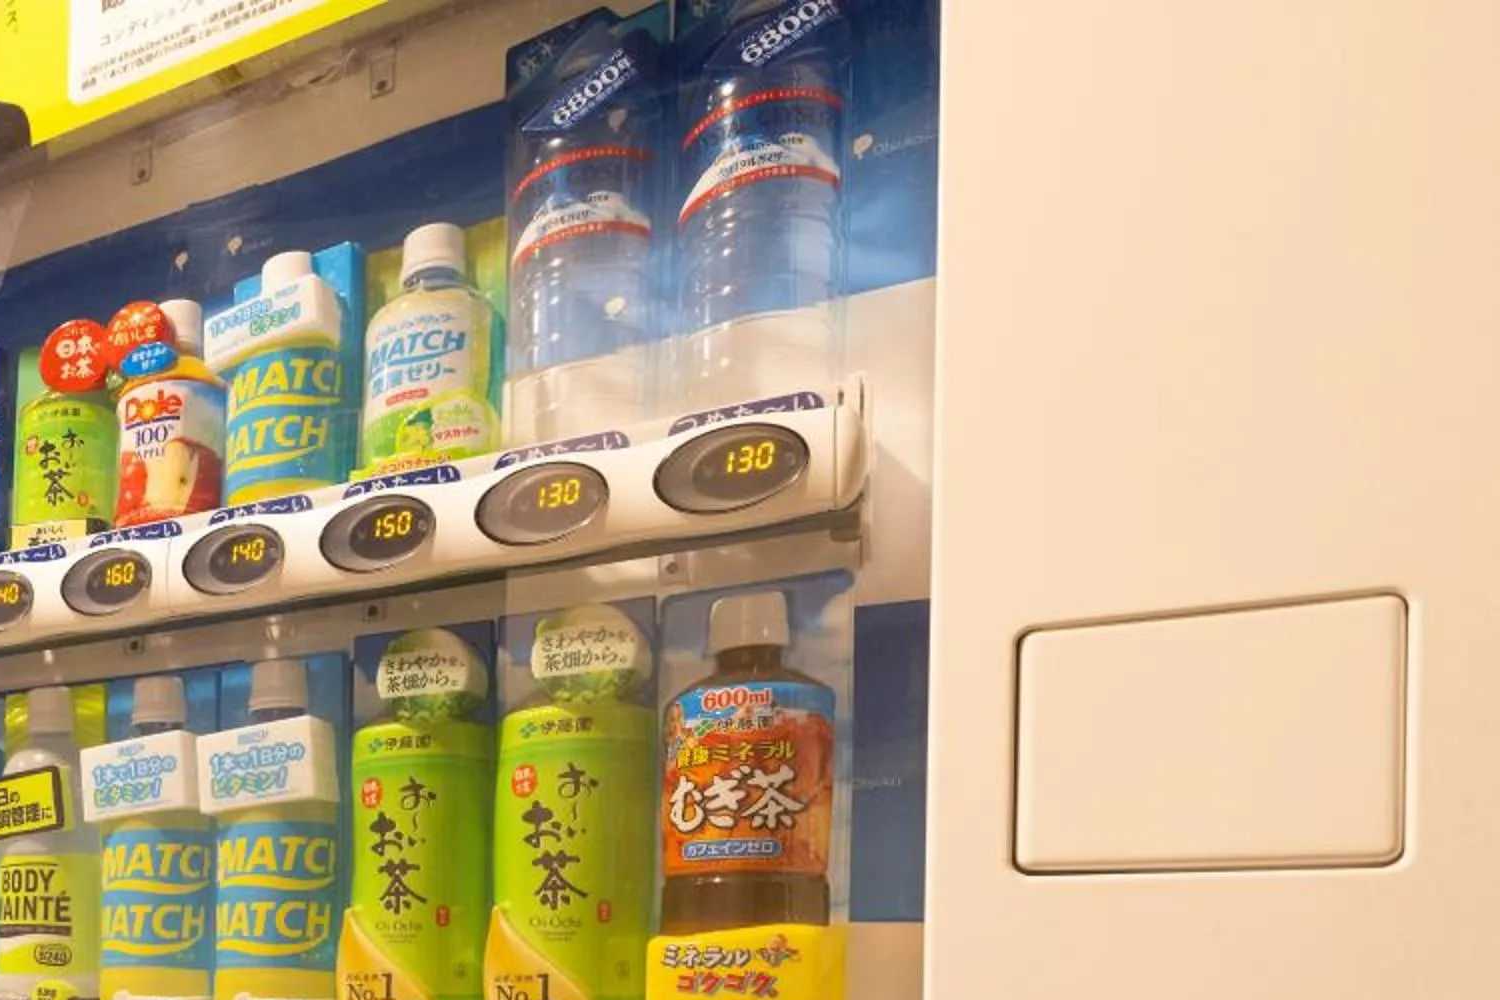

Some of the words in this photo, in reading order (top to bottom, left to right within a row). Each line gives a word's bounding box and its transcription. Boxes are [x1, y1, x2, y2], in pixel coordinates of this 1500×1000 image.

[125, 389, 183, 424] Dole
[726, 440, 776, 474] 130
[539, 479, 582, 508] 130
[375, 511, 412, 538] 150
[232, 537, 265, 563] 140
[105, 561, 136, 587] 160
[701, 687, 773, 710] 600ml
[669, 764, 804, 832] むぎ茶
[104, 842, 211, 883] MATC
[218, 835, 337, 887] MATC
[369, 811, 428, 915] お茶
[521, 799, 589, 912] お茶
[685, 840, 776, 858] カフェインゼロ
[1, 869, 56, 894] BODY
[661, 943, 751, 969] ミネラル
